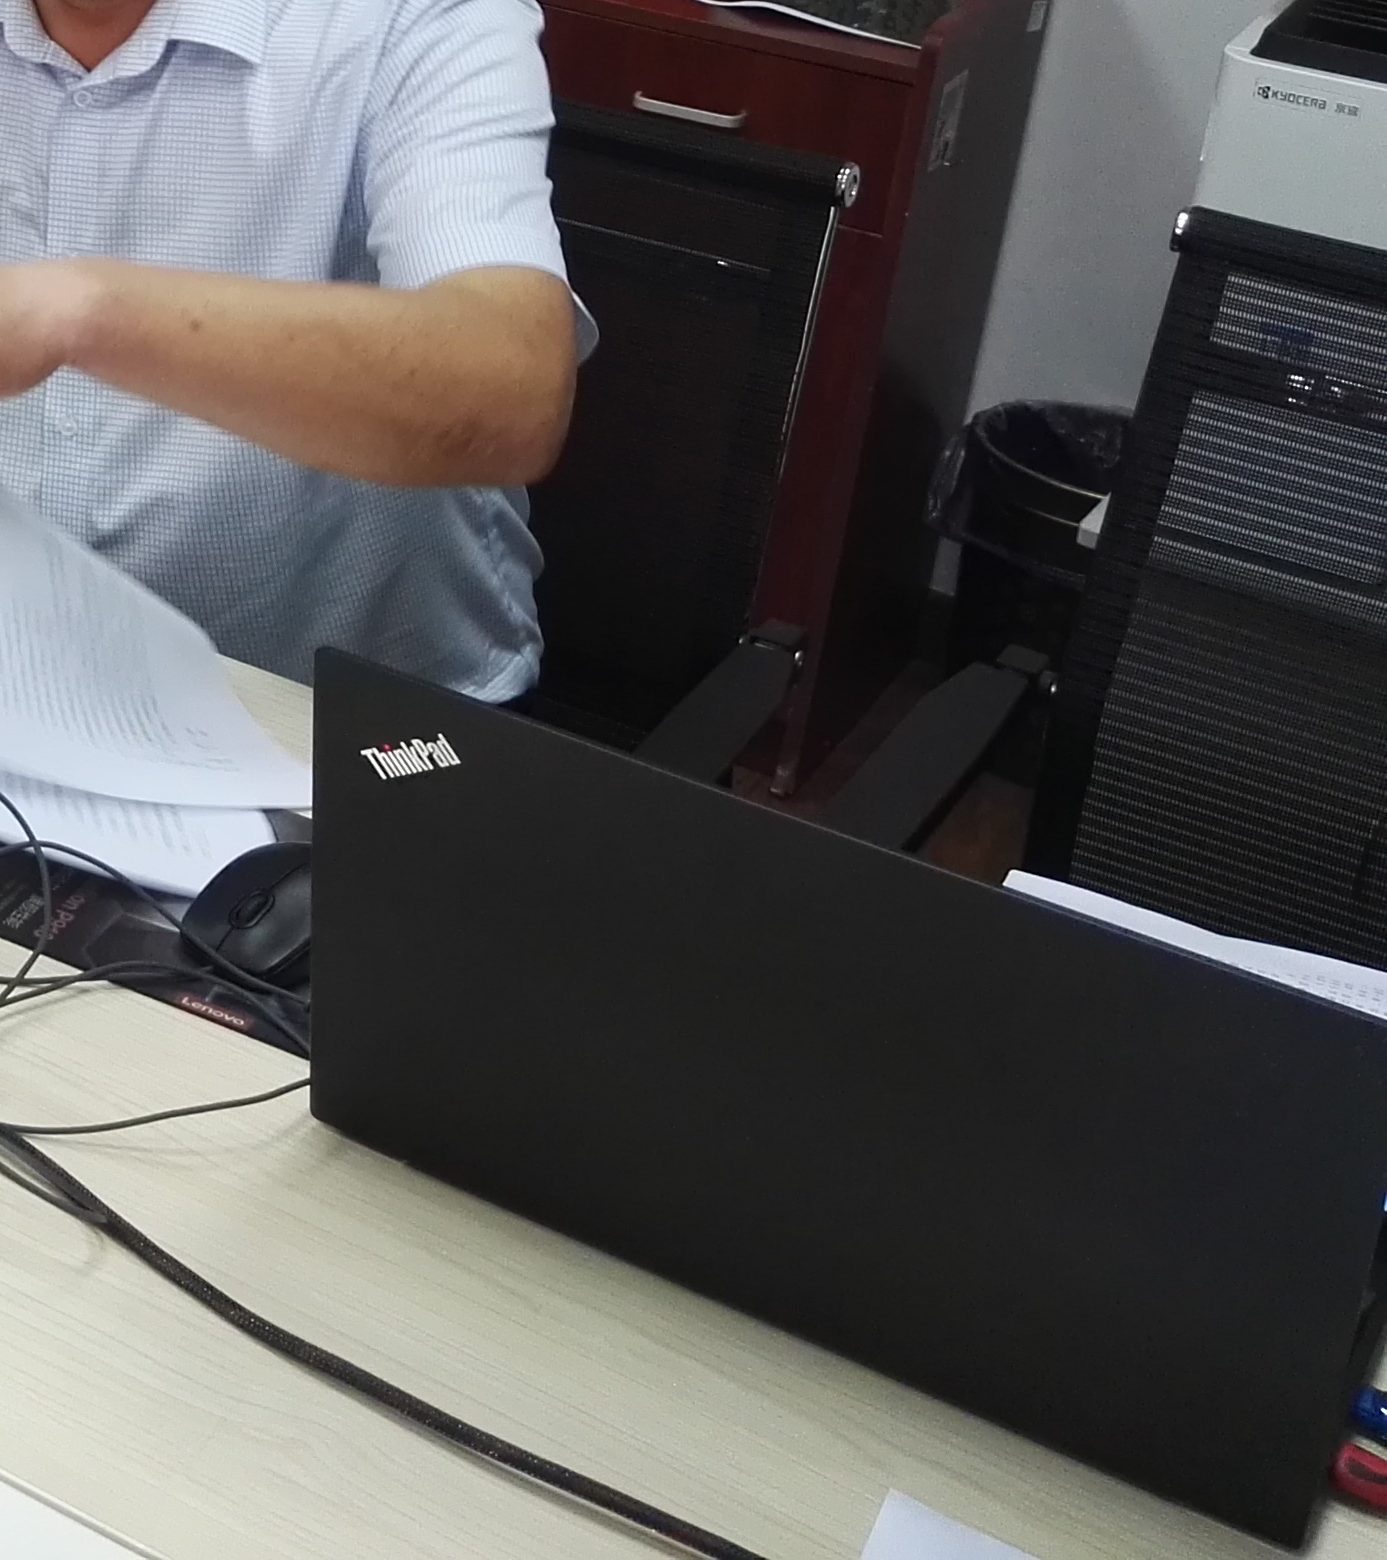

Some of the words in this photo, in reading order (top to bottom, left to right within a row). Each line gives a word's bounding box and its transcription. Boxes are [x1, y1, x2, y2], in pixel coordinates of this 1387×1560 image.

[1271, 89, 1327, 110] KYOCERA
[360, 733, 461, 780] ThinkPad
[180, 995, 246, 1027] Lenovo
